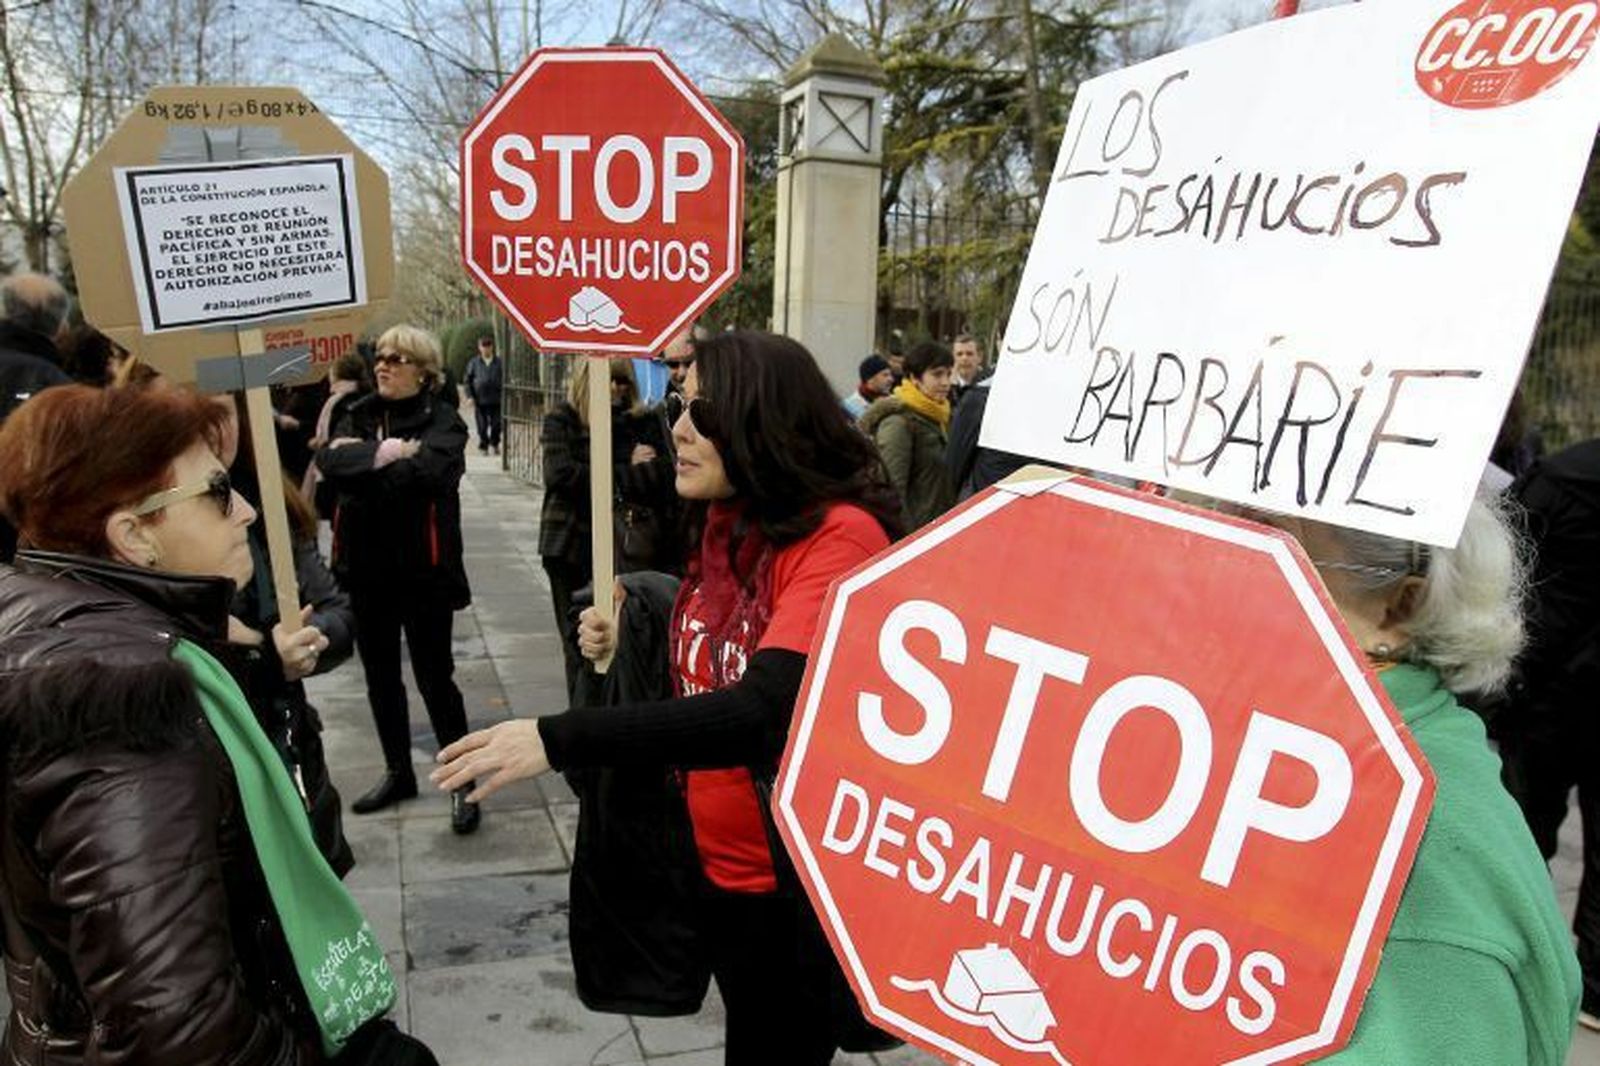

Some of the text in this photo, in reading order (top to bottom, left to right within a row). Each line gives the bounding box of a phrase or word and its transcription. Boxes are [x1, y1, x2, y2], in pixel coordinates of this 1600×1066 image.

[1059, 70, 1189, 182] LOS
[489, 133, 713, 225] STOP
[141, 196, 157, 205] DE
[161, 195, 178, 204] LA
[209, 207, 288, 225] RECONOCE
[293, 206, 310, 217] EL
[163, 225, 236, 241] DERECHO
[241, 223, 259, 234] DE
[237, 238, 246, 247] Y
[251, 234, 275, 246] SIN
[172, 240, 327, 265] EL EJERCICIO DE ESTE
[491, 234, 710, 284] DESAHUCIOS
[155, 263, 228, 280] DERECHO
[233, 261, 255, 272] NO
[857, 599, 1353, 888] STOP
[821, 778, 1286, 1035] DESAHUCIOS
